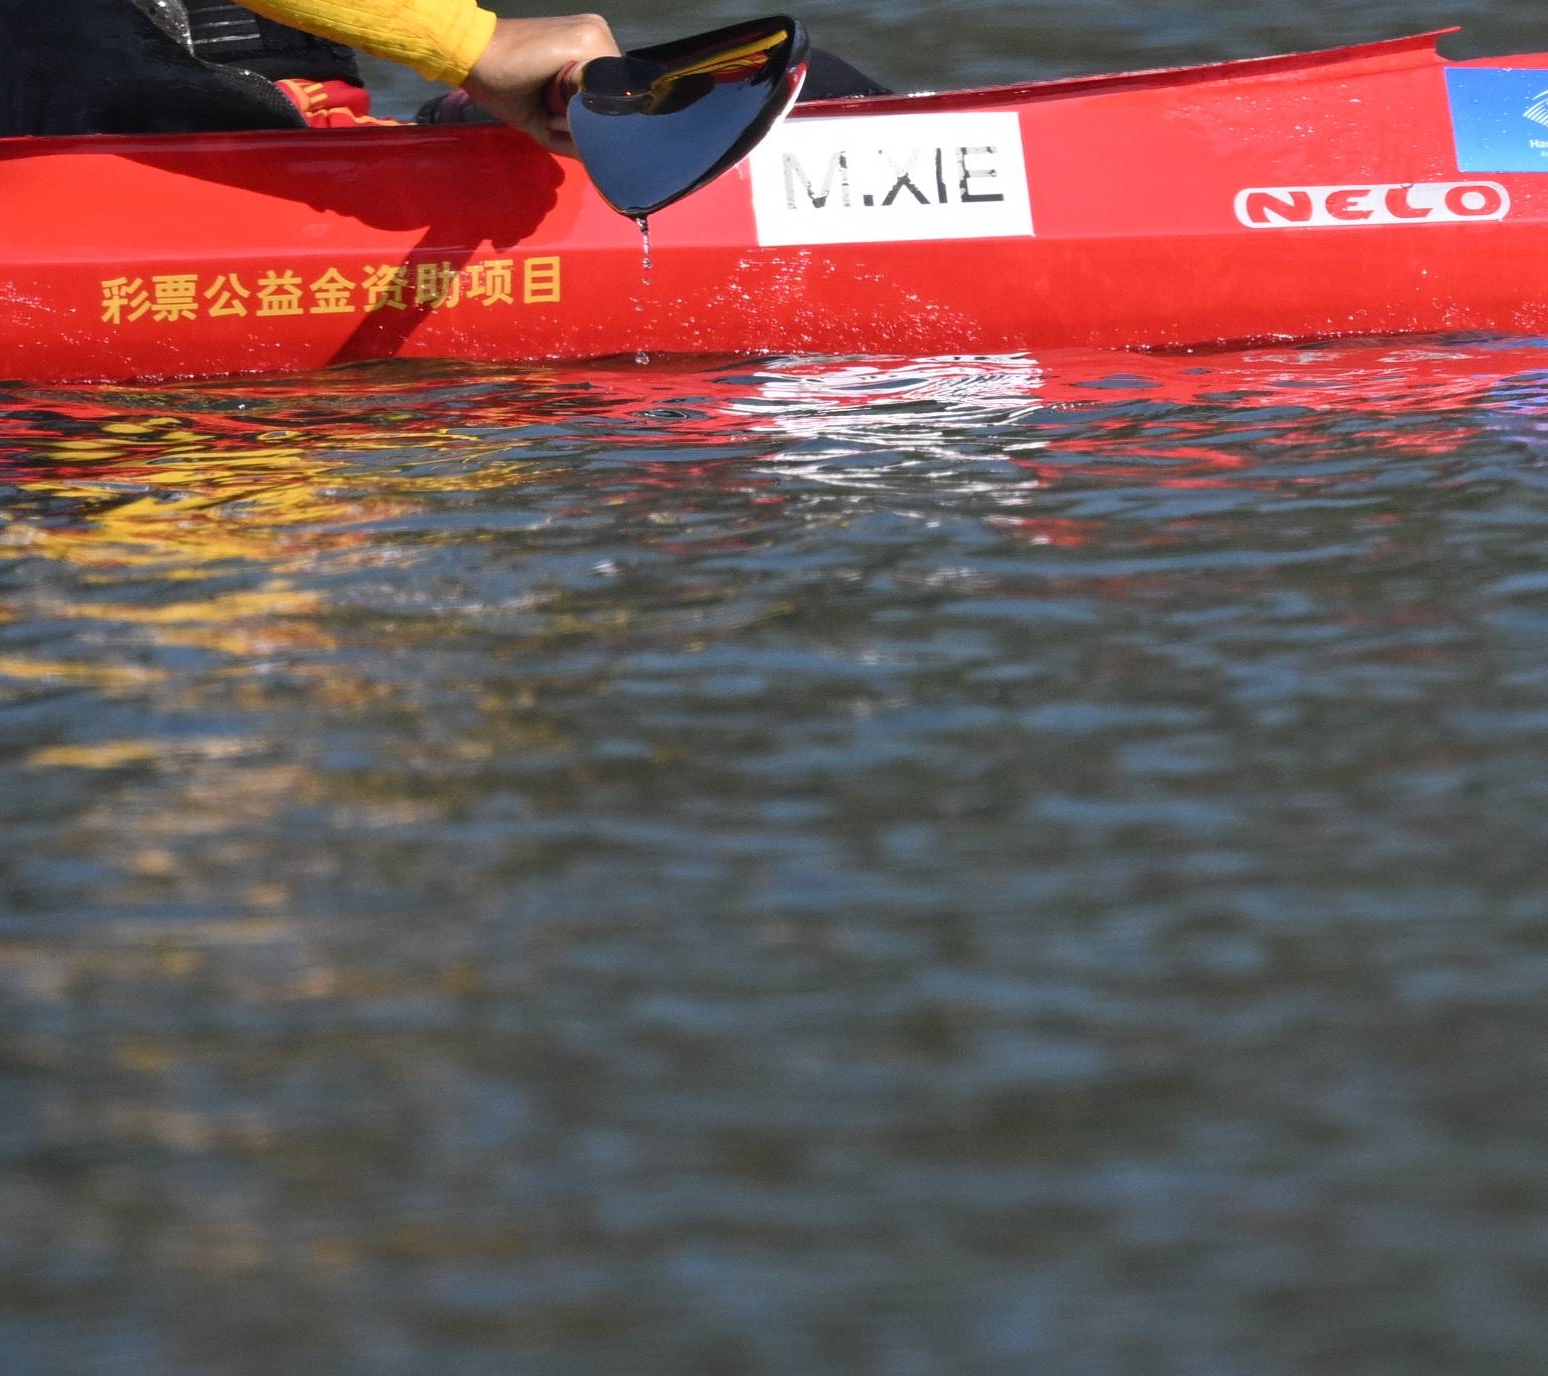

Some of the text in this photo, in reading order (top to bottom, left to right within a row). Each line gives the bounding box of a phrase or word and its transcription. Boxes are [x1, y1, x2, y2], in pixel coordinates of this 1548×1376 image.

[782, 146, 1004, 210] M.XIE
[1245, 184, 1503, 224] NELO
[100, 255, 562, 325] 彩票公益金资助项目
